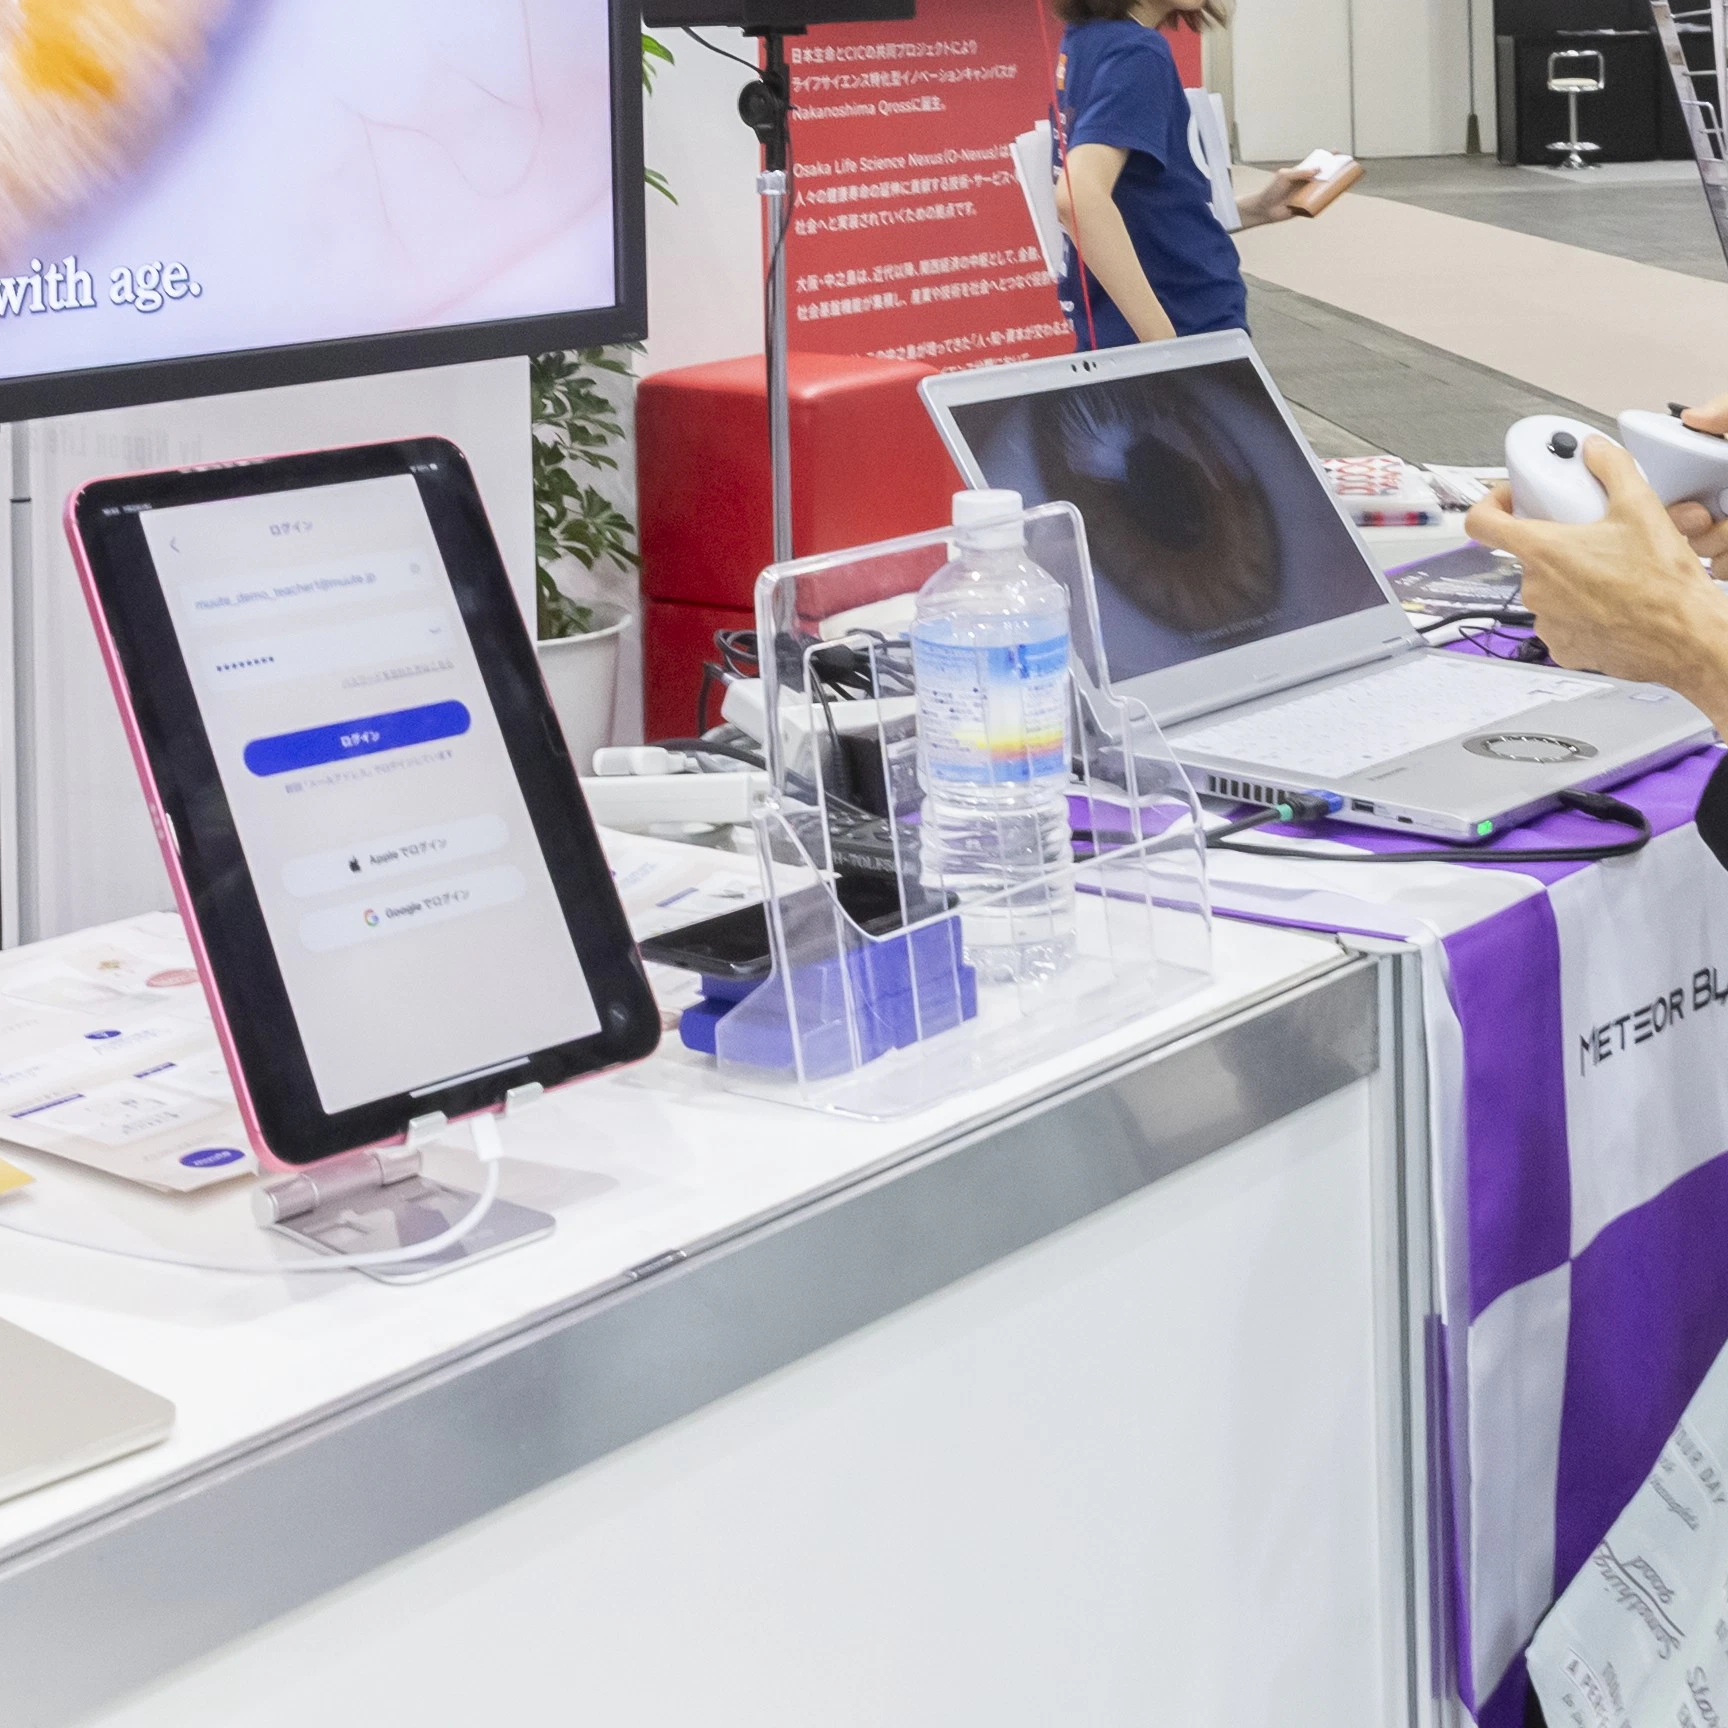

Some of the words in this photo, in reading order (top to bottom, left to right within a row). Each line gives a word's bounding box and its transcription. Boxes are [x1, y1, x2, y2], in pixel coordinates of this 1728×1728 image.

[793, 162, 832, 178] Osaka
[108, 256, 203, 316] age.
[340, 730, 381, 749] ログイン
[1579, 988, 1685, 1077] METEOR
